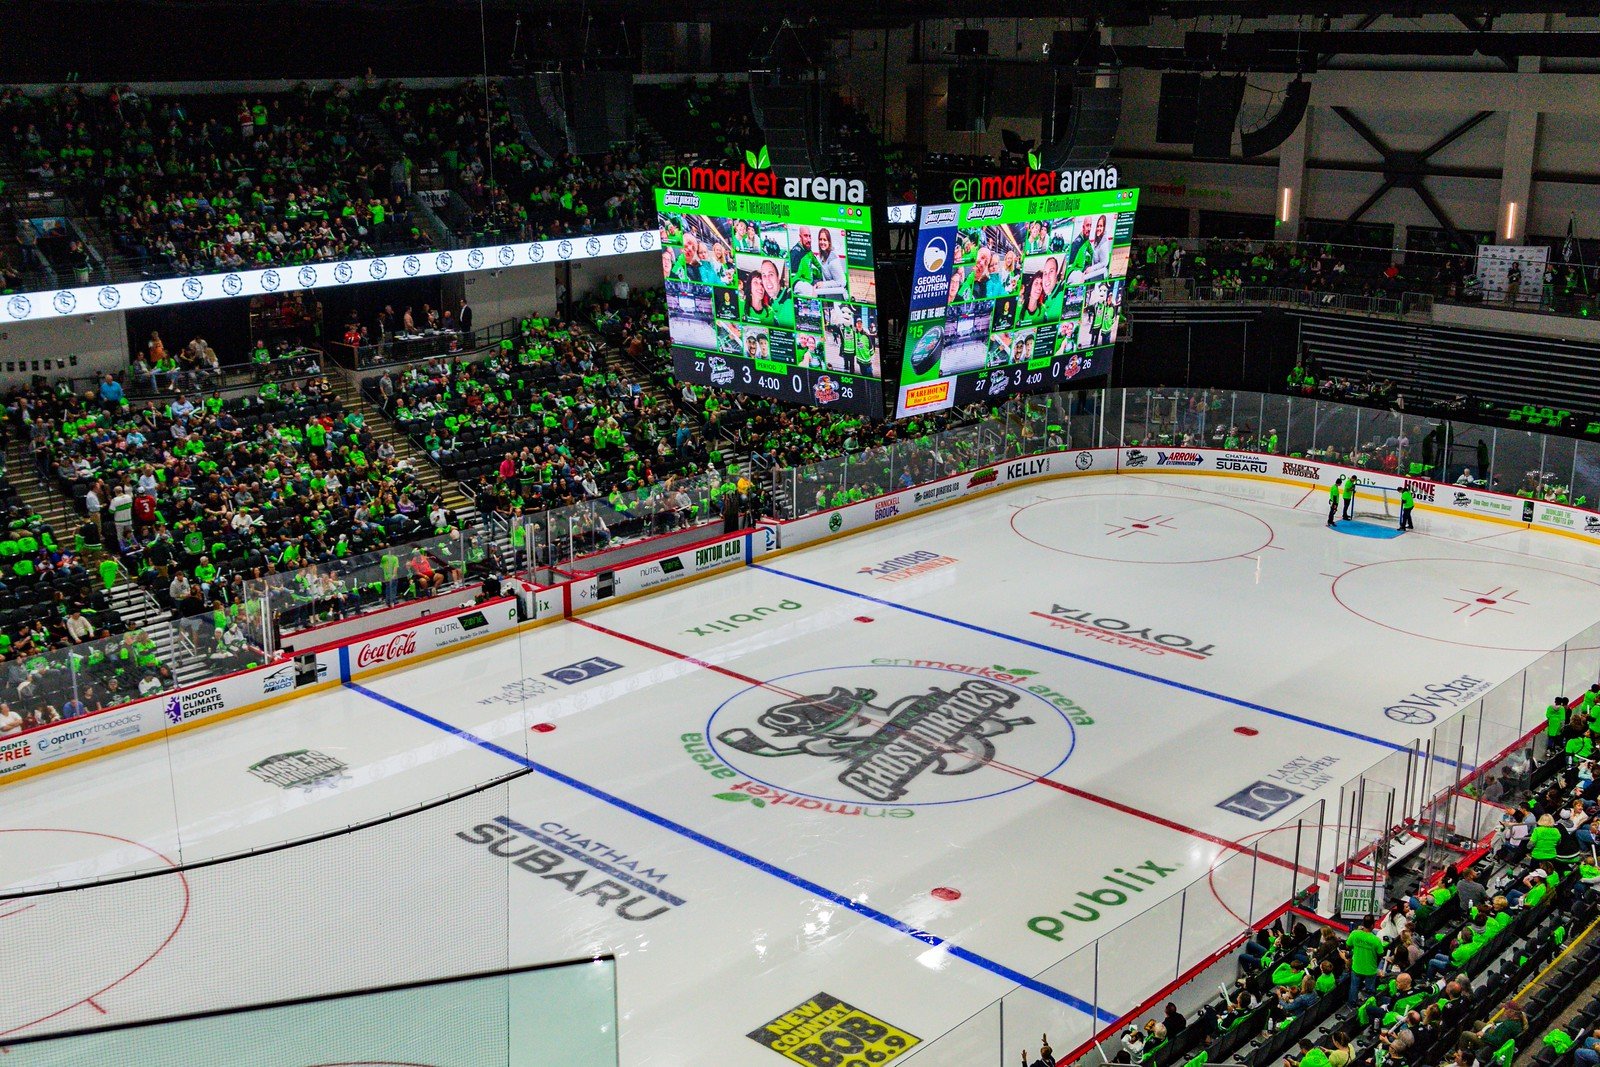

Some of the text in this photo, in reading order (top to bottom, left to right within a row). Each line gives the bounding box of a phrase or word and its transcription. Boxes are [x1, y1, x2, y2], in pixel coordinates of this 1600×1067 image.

[662, 163, 865, 203] enmarket arena
[953, 167, 1118, 202] enmarket arena
[914, 282, 948, 294] SOUTHERN
[917, 275, 946, 285] GEORGIA
[913, 291, 947, 300] UNIVERSITY
[695, 361, 705, 372] 27
[757, 361, 777, 371] PERIOD
[1052, 362, 1060, 377] 0
[1082, 359, 1091, 369] 26
[742, 365, 752, 384] 3
[758, 376, 779, 390] 4:00
[792, 374, 802, 393] 0
[1014, 369, 1021, 385] 3
[1026, 373, 1042, 384] 4:00
[841, 386, 853, 398] 26
[910, 386, 945, 398] WAREHOUSE
[975, 380, 986, 391] 27
[1168, 452, 1198, 461] ARROW
[1225, 453, 1260, 461] CHATHAM
[1007, 458, 1045, 480] KELLY
[1216, 461, 1268, 473] SUBARU
[1282, 469, 1320, 480] RUDDERS
[1404, 480, 1436, 496] HOWE
[1409, 491, 1435, 502] OOFS
[874, 506, 894, 520] GROUP
[725, 540, 741, 557] CLUB
[687, 598, 803, 638] publix
[1050, 603, 1216, 657] TOYOTA
[1050, 621, 1166, 656] CHATHAM
[357, 630, 417, 668] Coca-Cola
[553, 659, 616, 681] LC
[182, 687, 217, 702] INDOOR
[870, 656, 1096, 727] enmarket arena
[1399, 674, 1484, 707] VyStar
[183, 694, 222, 710] CLIMATE
[183, 701, 224, 719] EXPERTS
[855, 694, 940, 757] SAVNNAH
[845, 682, 1010, 800] GHOST PIRATES
[679, 732, 915, 819] enmarket arena
[1267, 756, 1307, 780] LASKY
[1285, 755, 1340, 786] COOPER
[1303, 773, 1334, 791] LAW
[1226, 784, 1293, 819] LC
[540, 822, 668, 883] CHATHAM
[455, 823, 671, 922] SUBARU
[1027, 859, 1176, 942] publix
[1343, 888, 1359, 898] KID'S
[765, 1000, 823, 1035] NEW
[771, 1002, 851, 1051] COUNTRY
[792, 1016, 889, 1067] BOB
